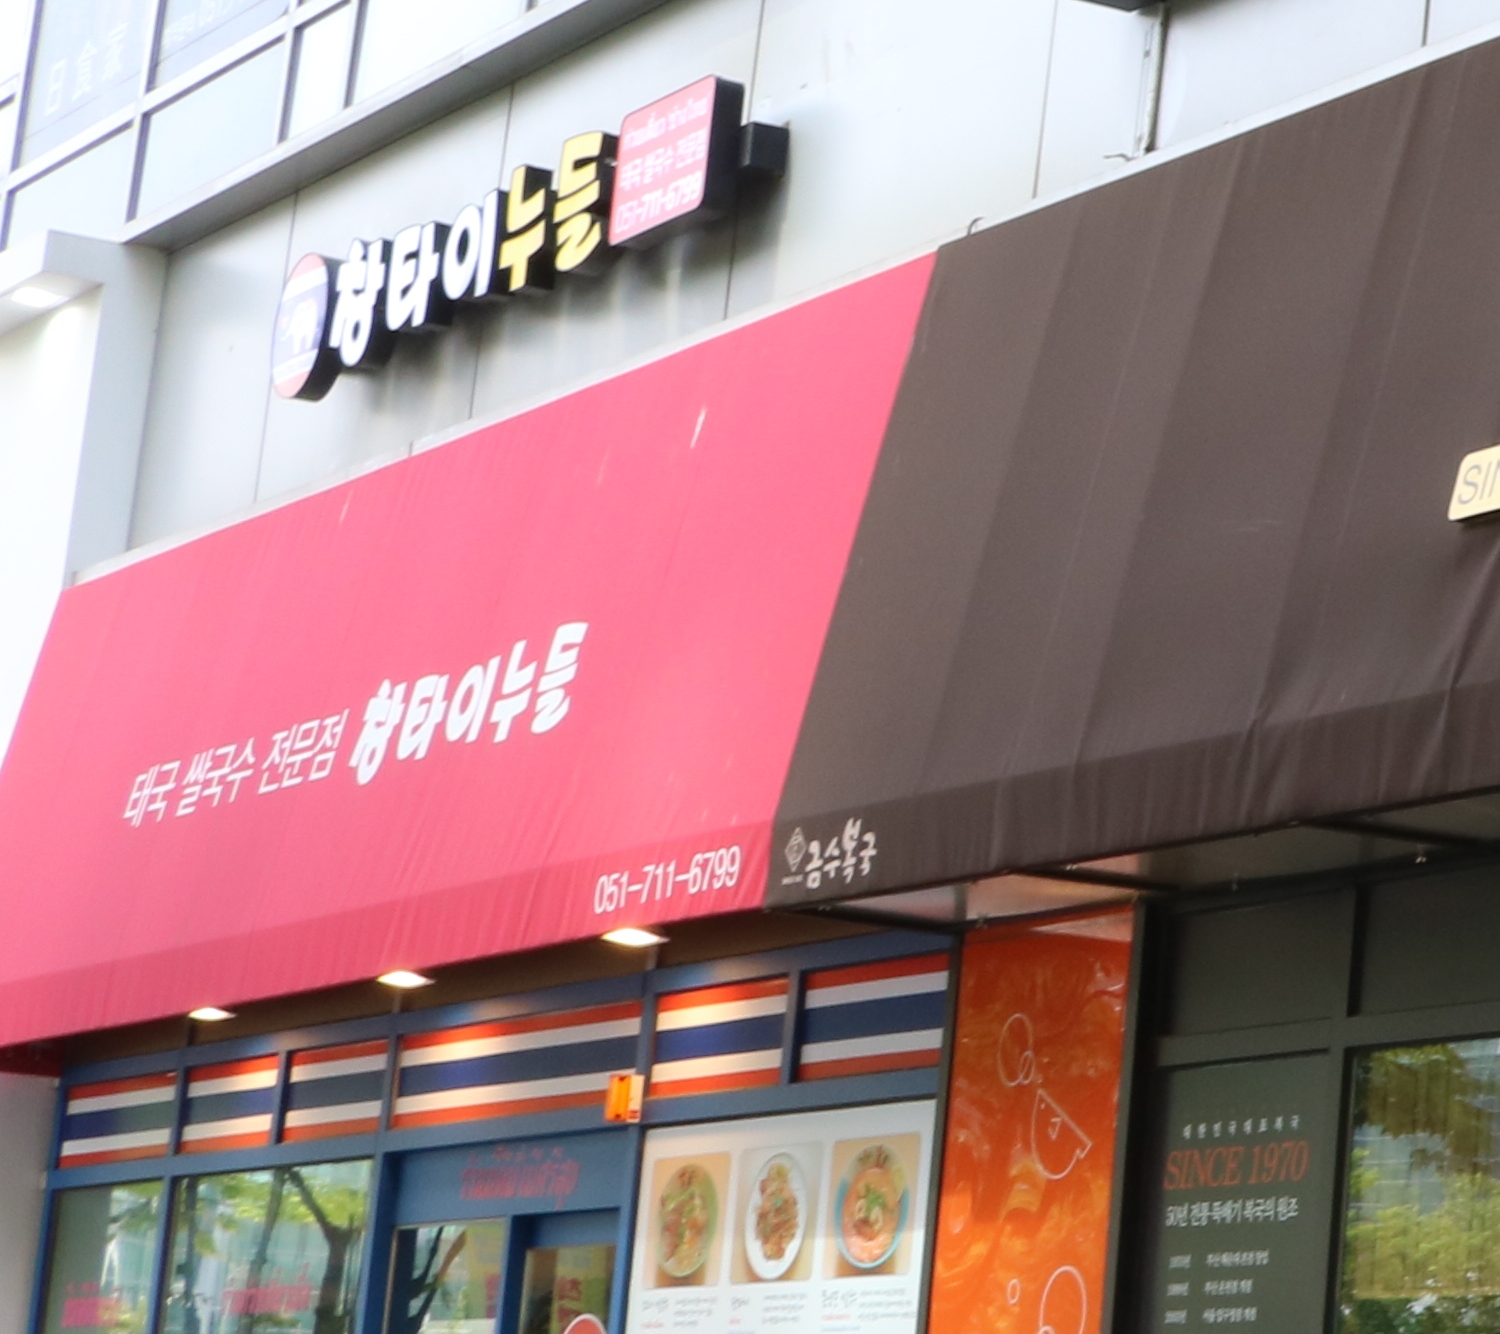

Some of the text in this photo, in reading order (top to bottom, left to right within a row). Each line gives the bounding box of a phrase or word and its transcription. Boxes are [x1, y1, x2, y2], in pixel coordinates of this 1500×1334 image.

[329, 131, 602, 367] 창타이누들
[124, 622, 589, 828] 태국 쌀국수 전문점 창타이누들
[594, 845, 742, 917] 051-711-6799
[805, 817, 877, 889] 금수복국
[1163, 1139, 1311, 1191] SINCE 1970
